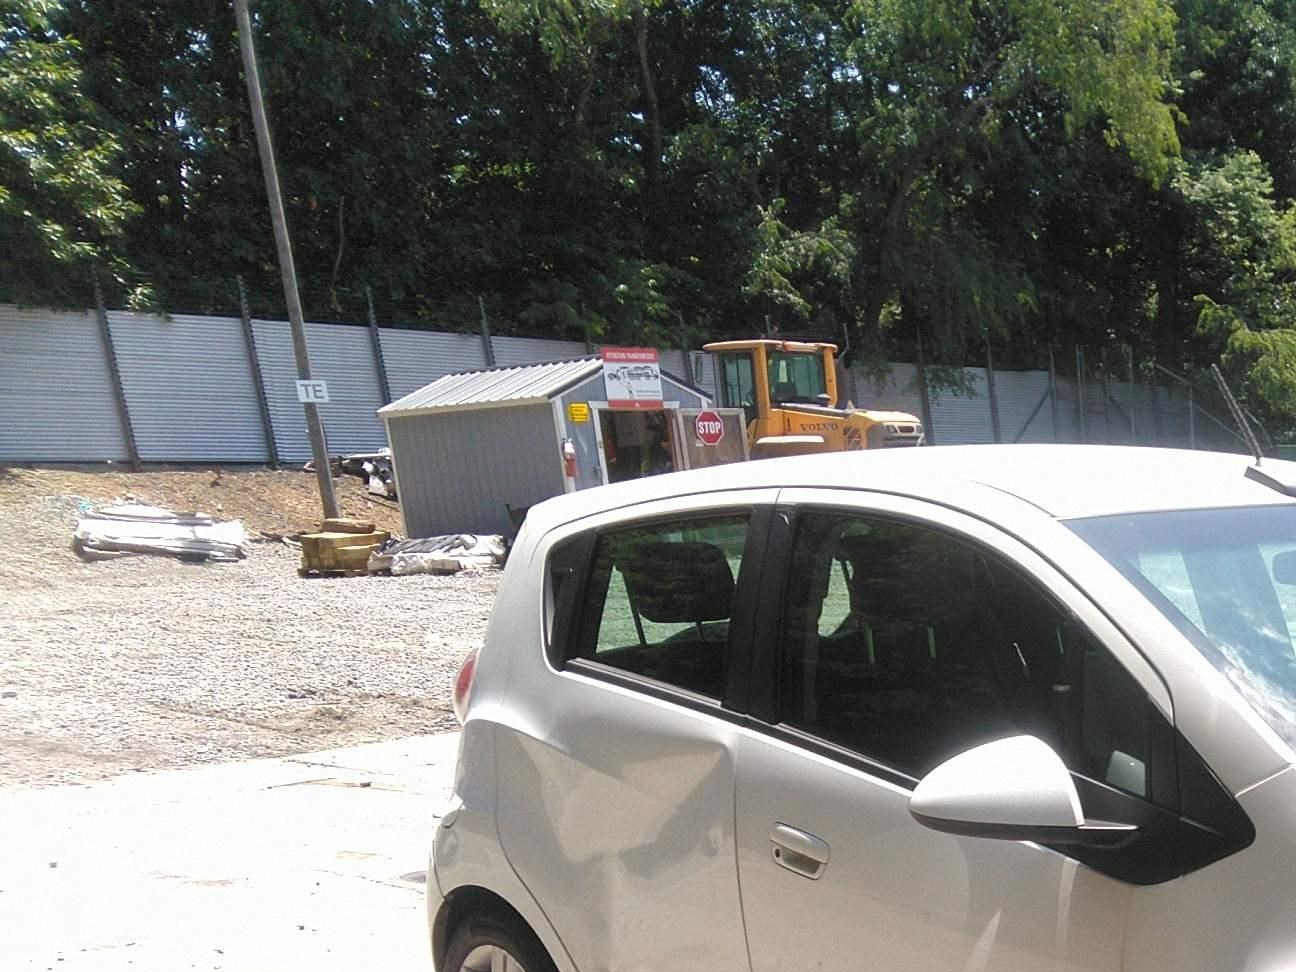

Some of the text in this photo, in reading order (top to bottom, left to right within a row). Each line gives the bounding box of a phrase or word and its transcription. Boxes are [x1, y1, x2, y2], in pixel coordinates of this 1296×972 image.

[300, 384, 325, 399] TE
[698, 421, 721, 434] STOP
[800, 423, 839, 432] VOLVO
